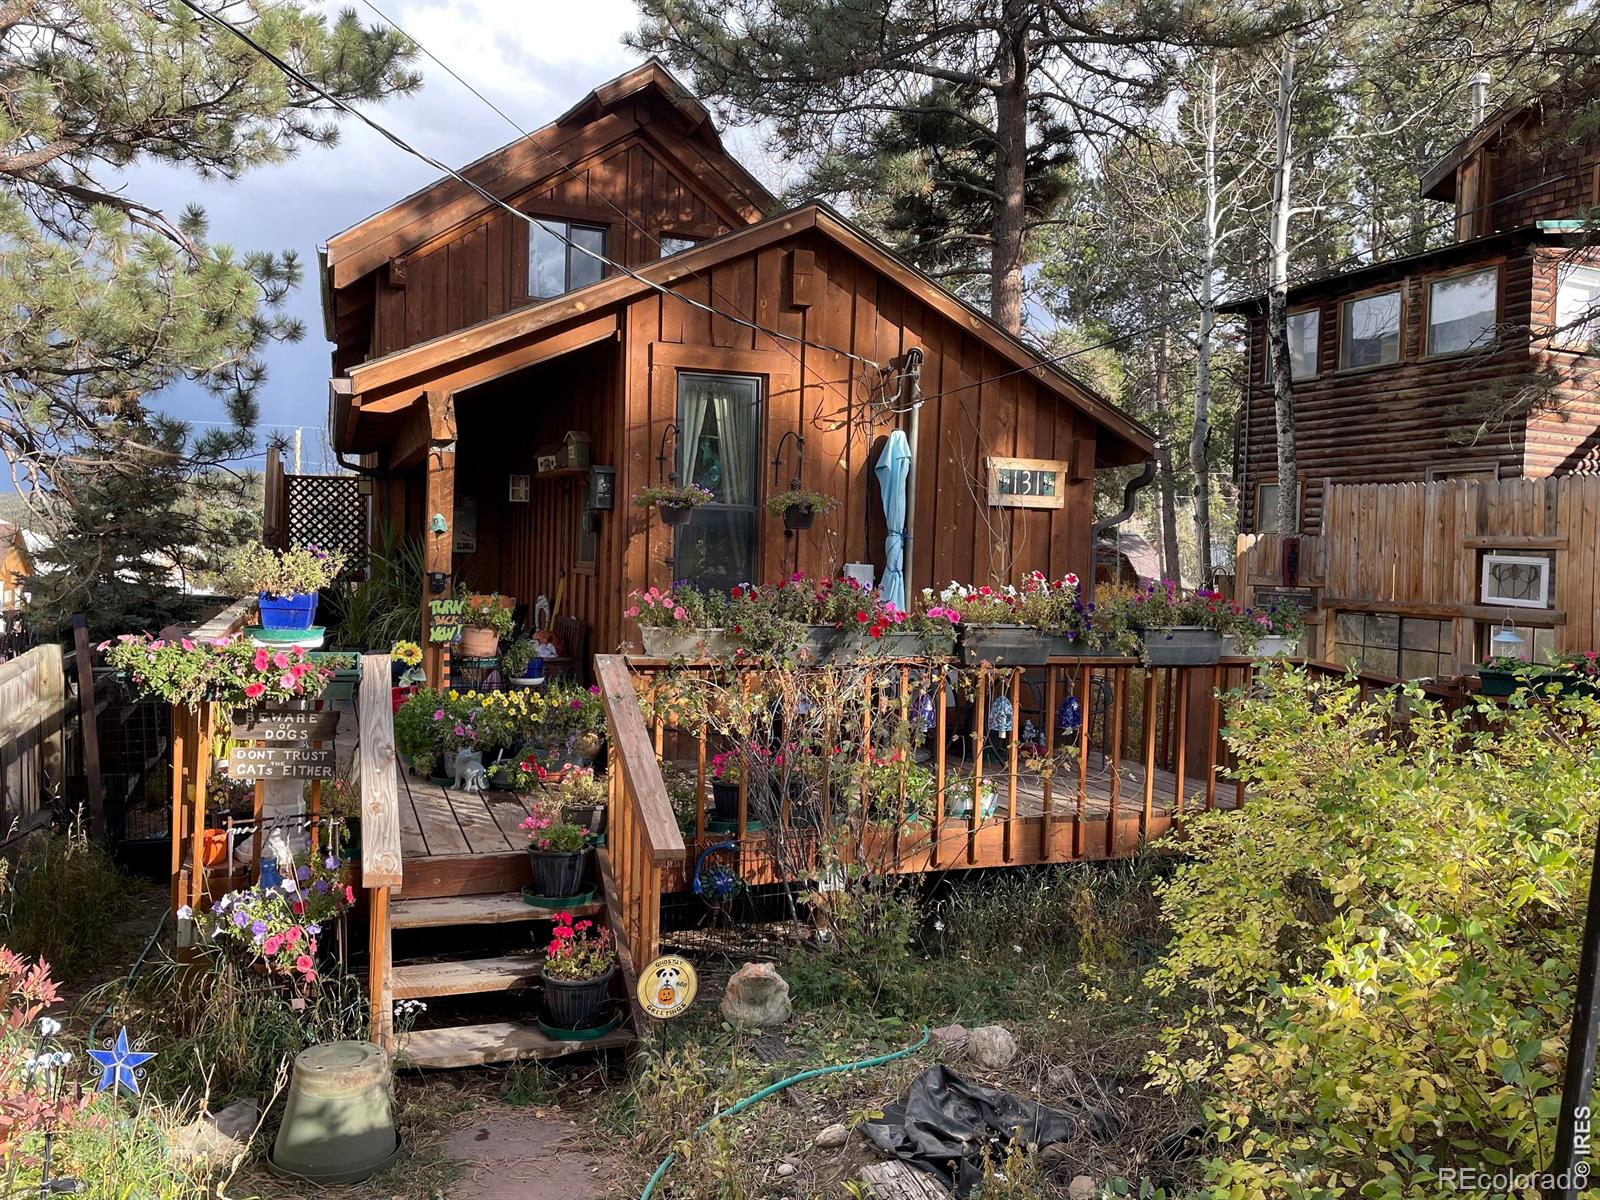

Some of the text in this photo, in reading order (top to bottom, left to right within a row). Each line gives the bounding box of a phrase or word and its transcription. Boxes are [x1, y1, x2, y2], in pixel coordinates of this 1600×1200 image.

[1013, 470, 1040, 495] 131
[428, 600, 465, 615] TURN
[434, 615, 460, 625] BACK
[245, 711, 319, 724] BEWARE
[265, 729, 308, 740] DOGS
[284, 750, 328, 761] TRUST
[282, 765, 332, 777] EITHER
